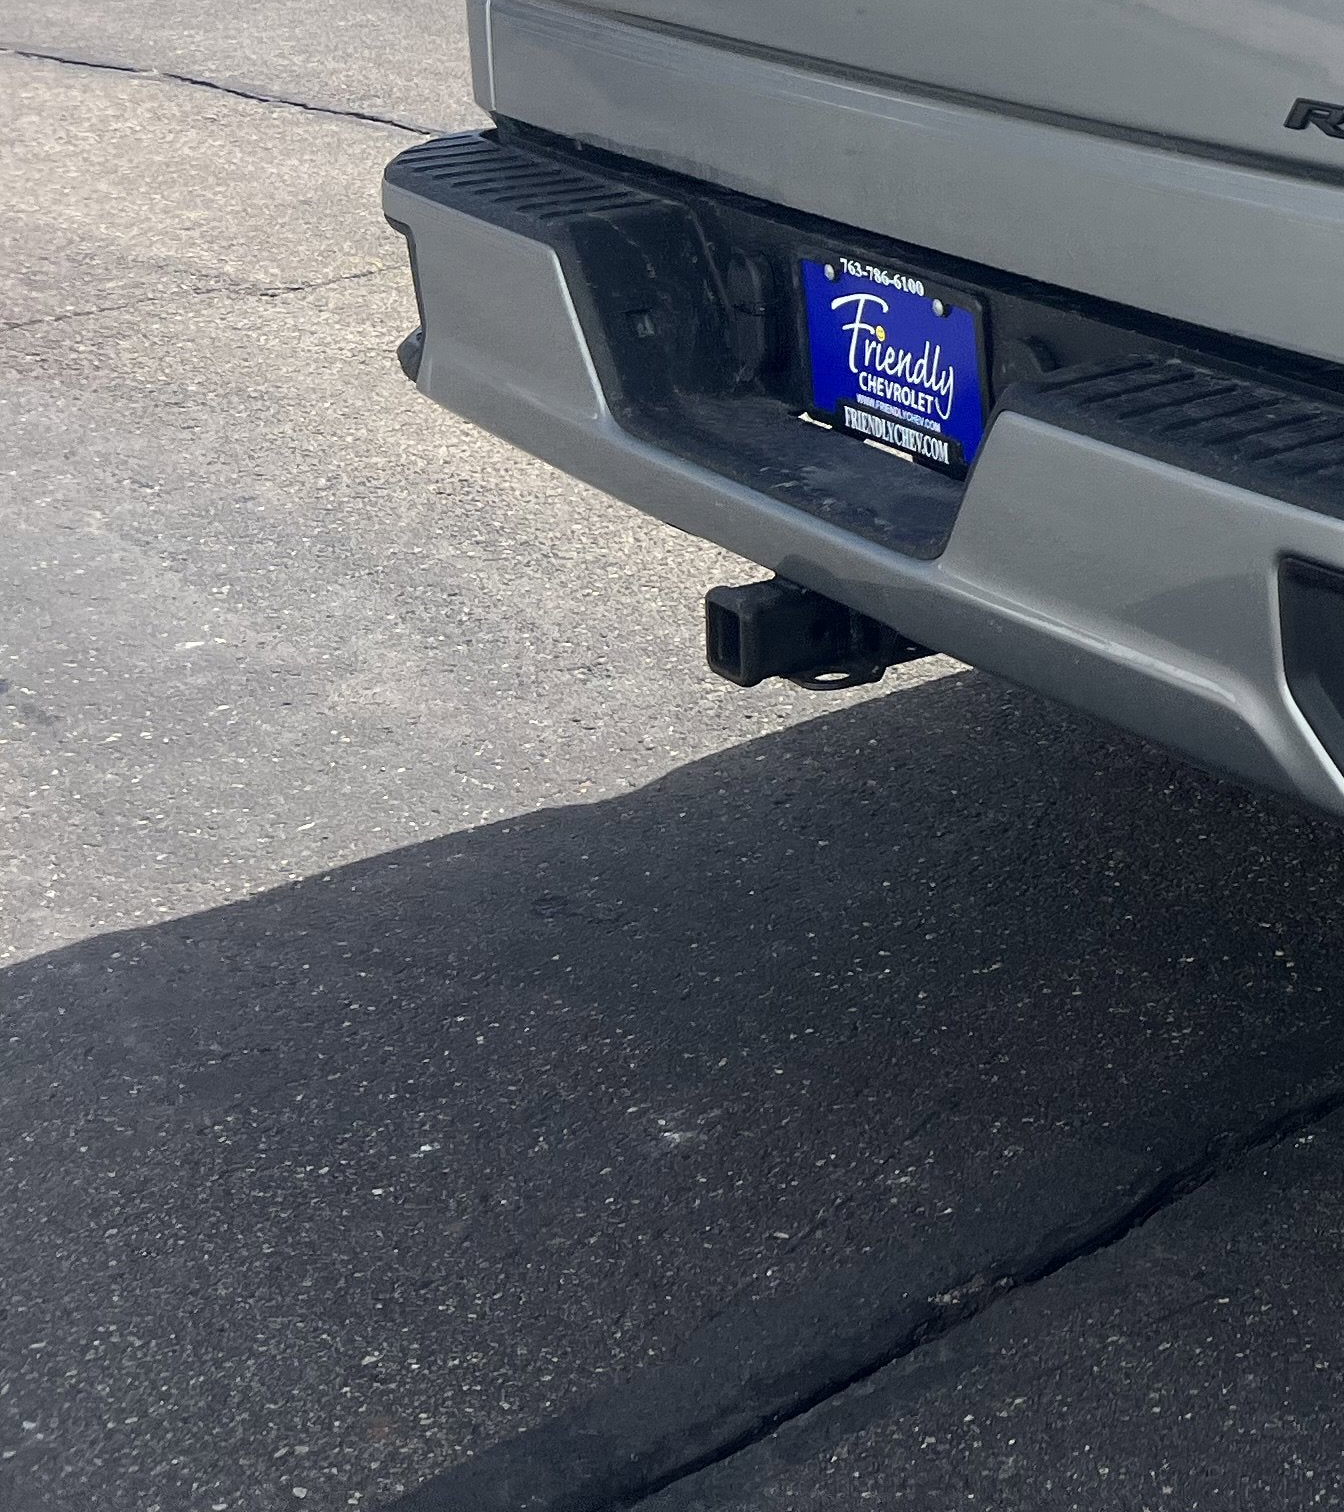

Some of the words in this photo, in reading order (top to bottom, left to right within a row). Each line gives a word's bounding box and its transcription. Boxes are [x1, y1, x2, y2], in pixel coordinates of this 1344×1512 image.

[839, 257, 925, 297] 763-786-6100
[831, 293, 954, 420] Friendly
[858, 371, 934, 415] CHEVROLET
[843, 404, 950, 465] FRIENDLYCHEV.COM
